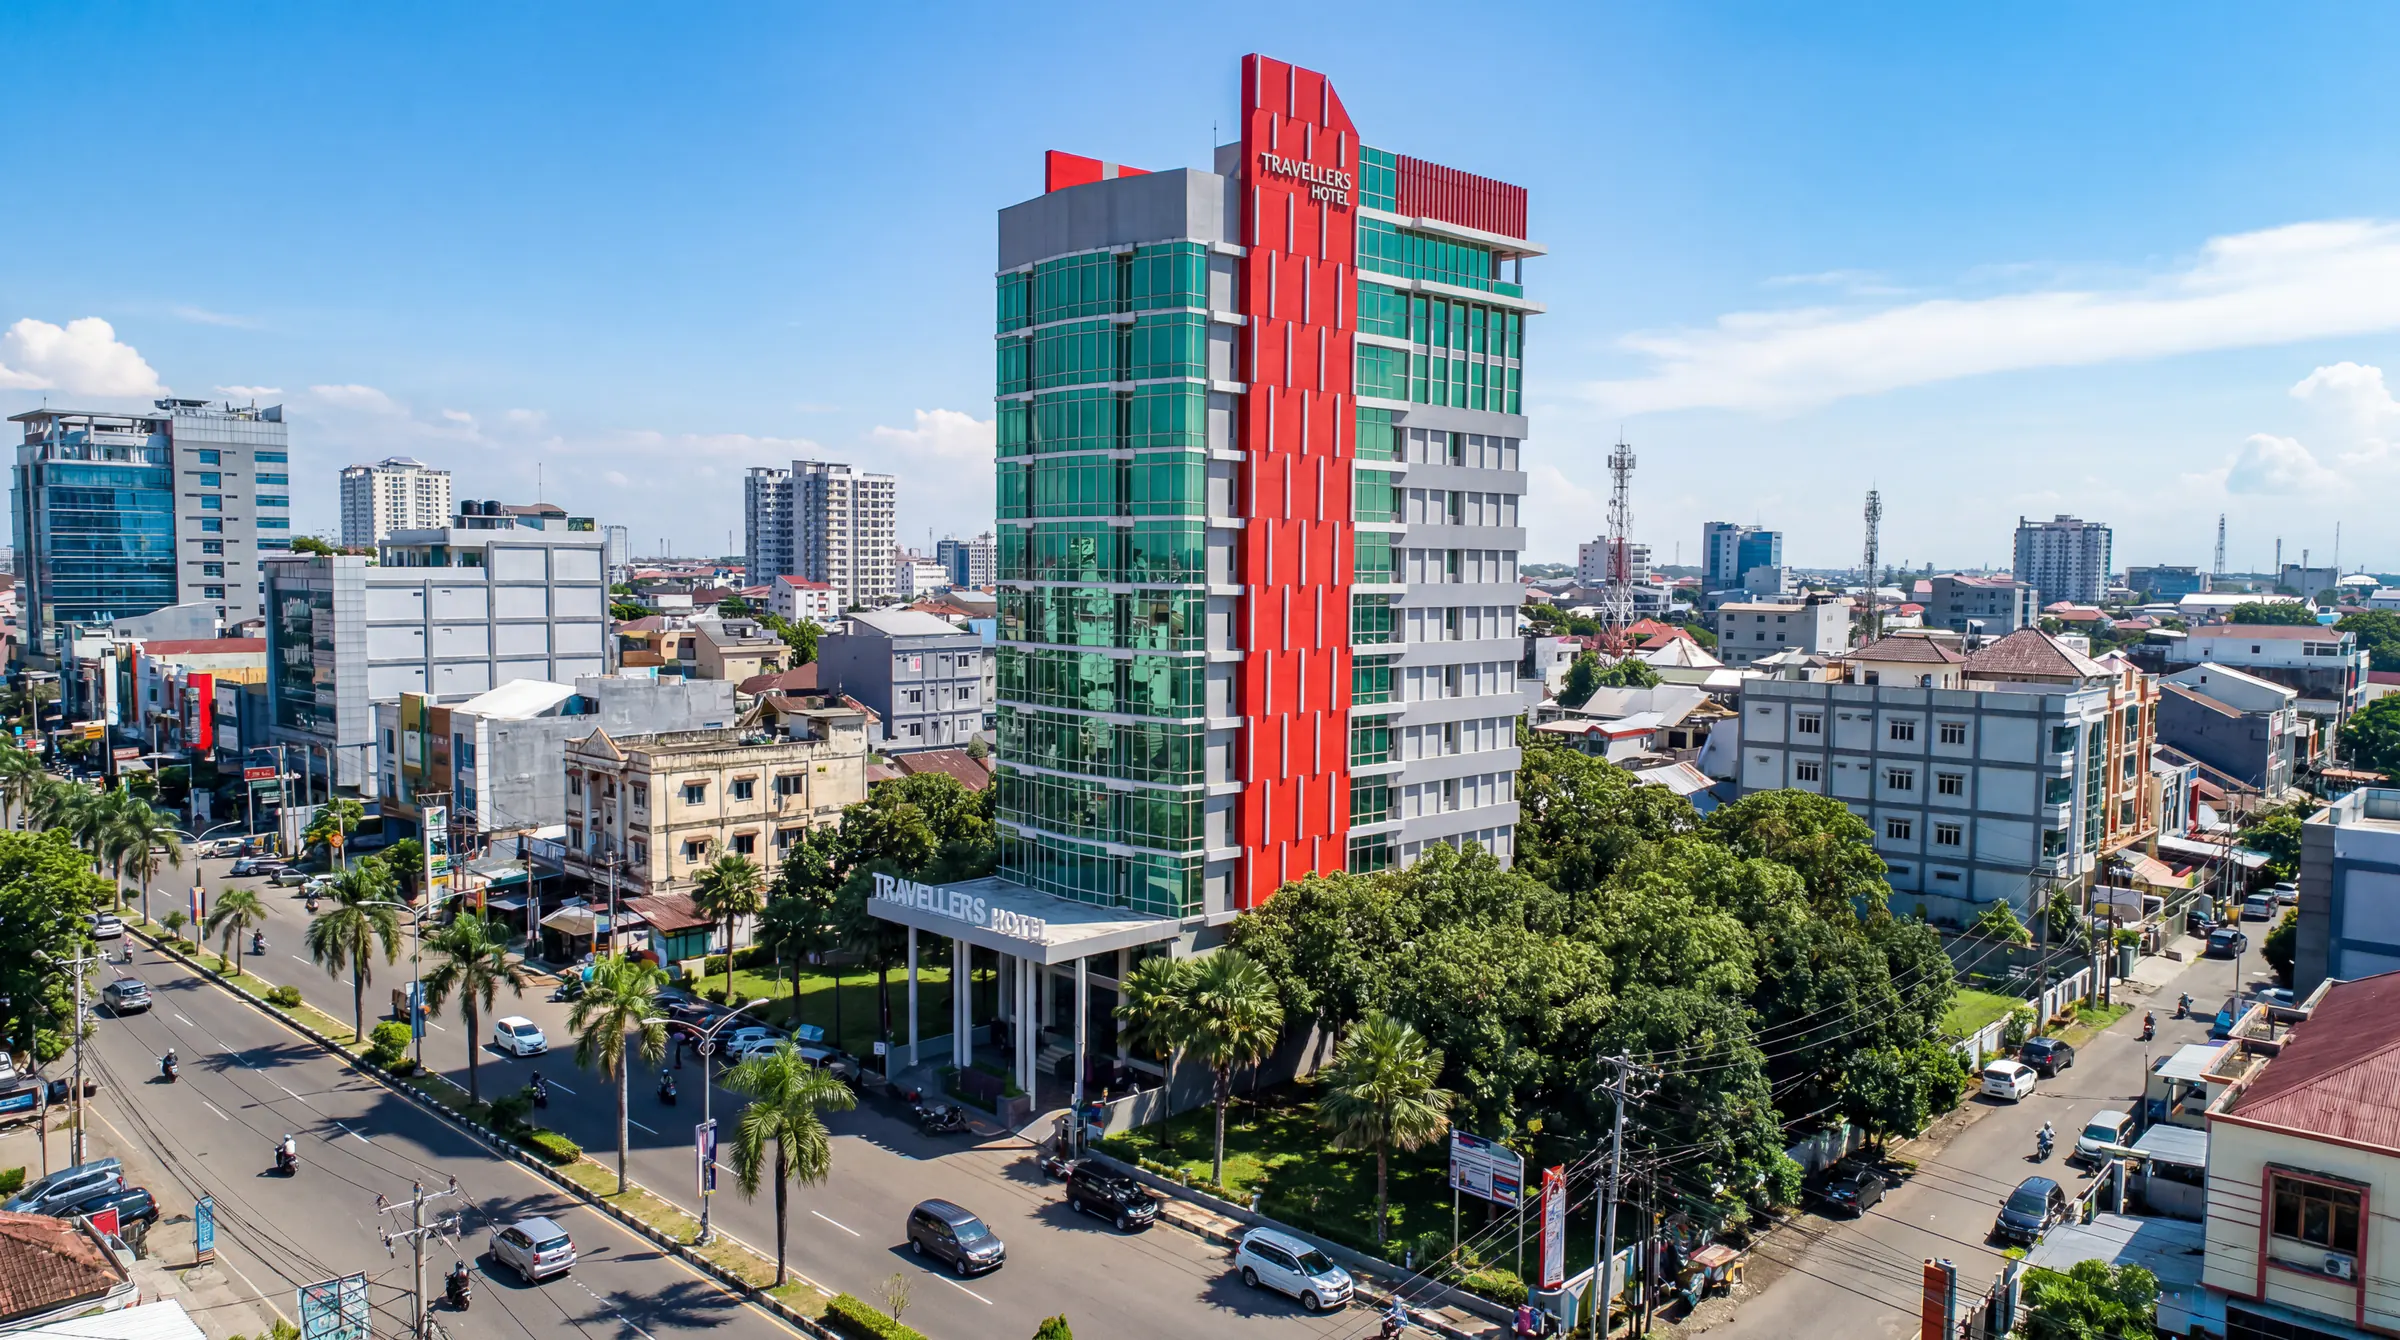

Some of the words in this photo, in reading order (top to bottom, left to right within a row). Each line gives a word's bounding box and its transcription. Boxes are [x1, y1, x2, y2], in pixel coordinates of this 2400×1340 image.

[1261, 152, 1351, 190] TRAVELLERS
[1311, 184, 1350, 206] HOTEL
[872, 872, 986, 925] TRAVELLERS
[991, 907, 1047, 941] HOTEL
